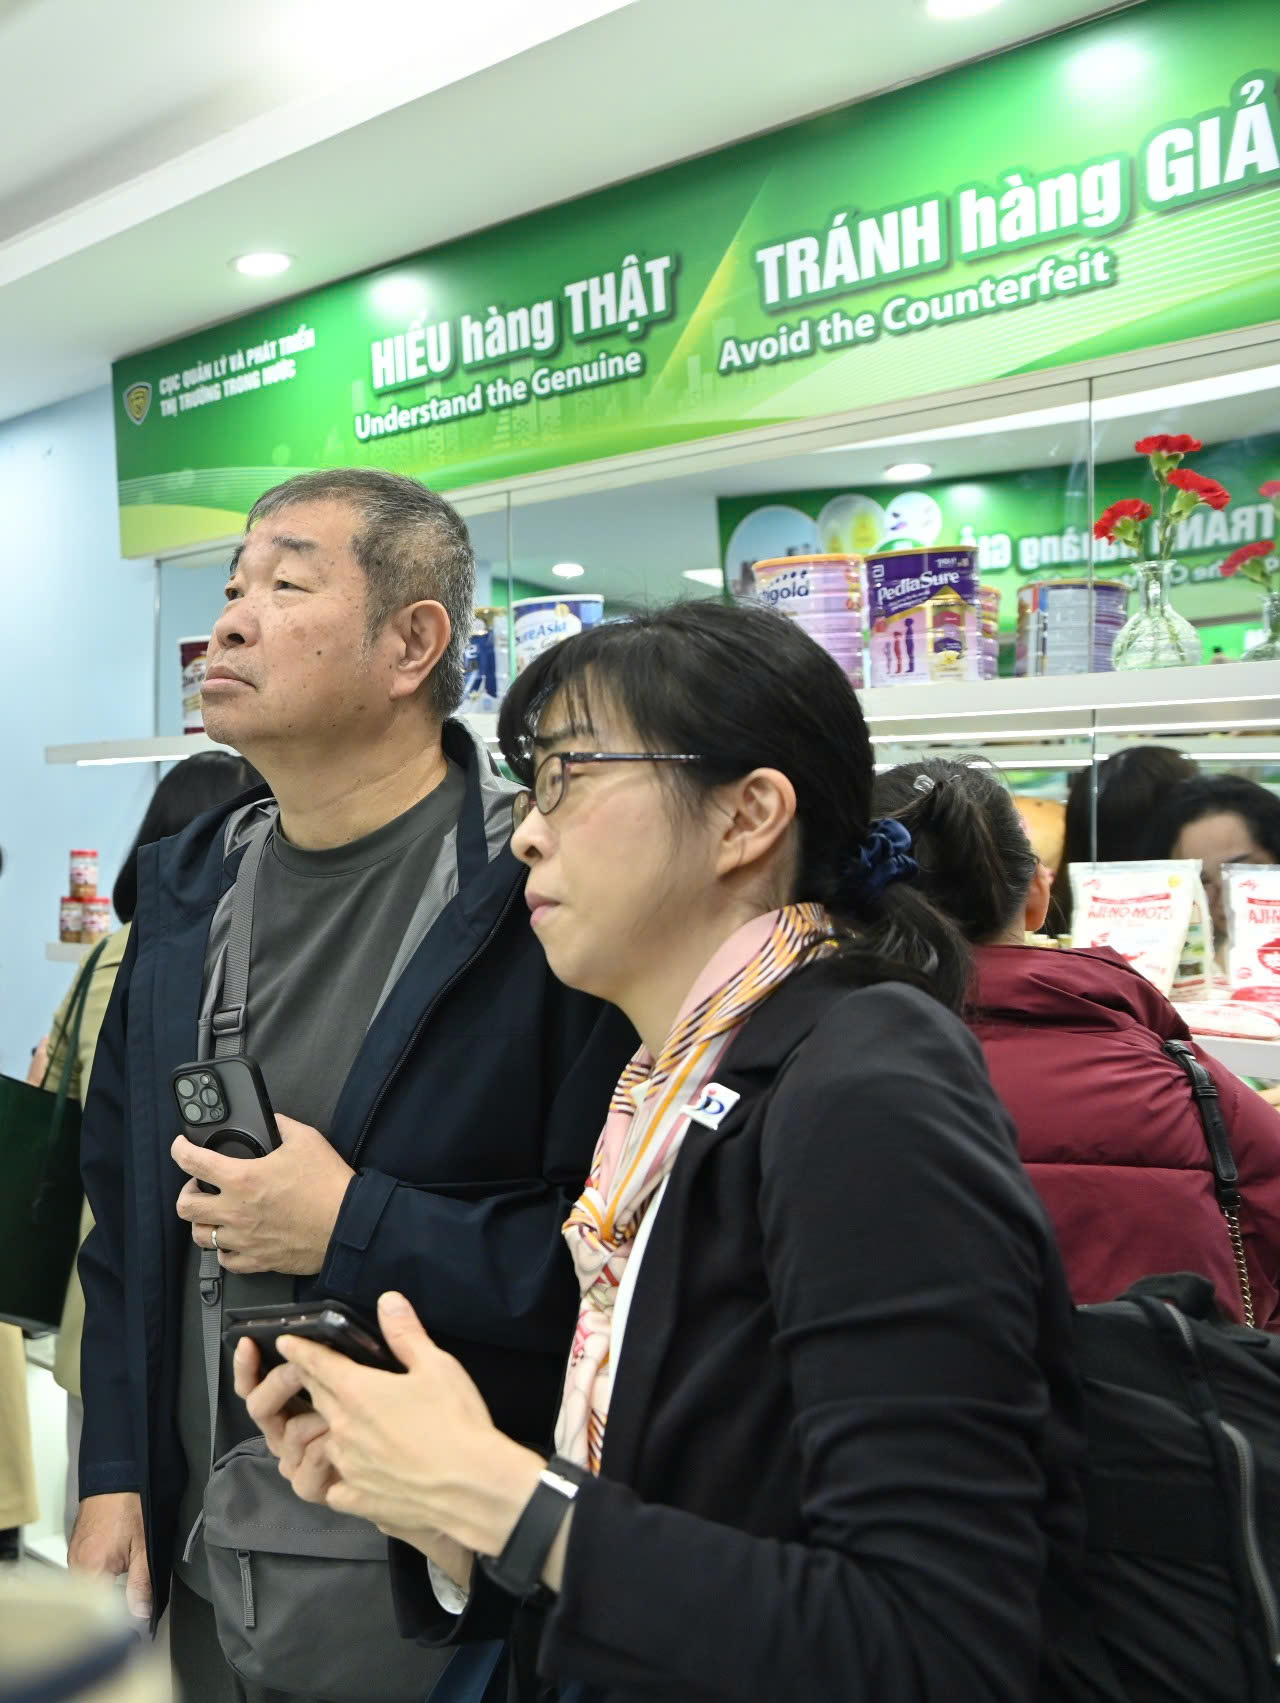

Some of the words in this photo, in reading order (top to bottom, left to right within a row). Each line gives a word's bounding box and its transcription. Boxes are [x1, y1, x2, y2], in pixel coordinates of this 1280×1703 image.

[756, 213, 941, 305] TRÁNH
[958, 174, 1121, 254] hàng
[1147, 79, 1280, 202] GIẢ
[460, 300, 555, 364] hàng
[564, 254, 671, 334] THẬT
[718, 320, 811, 371] Avoid
[817, 311, 876, 347] the
[882, 250, 1111, 330] Counterfeit
[354, 384, 483, 440] Understand
[486, 378, 527, 405] the
[531, 351, 641, 396] Genuine
[876, 570, 960, 606] PediaSure
